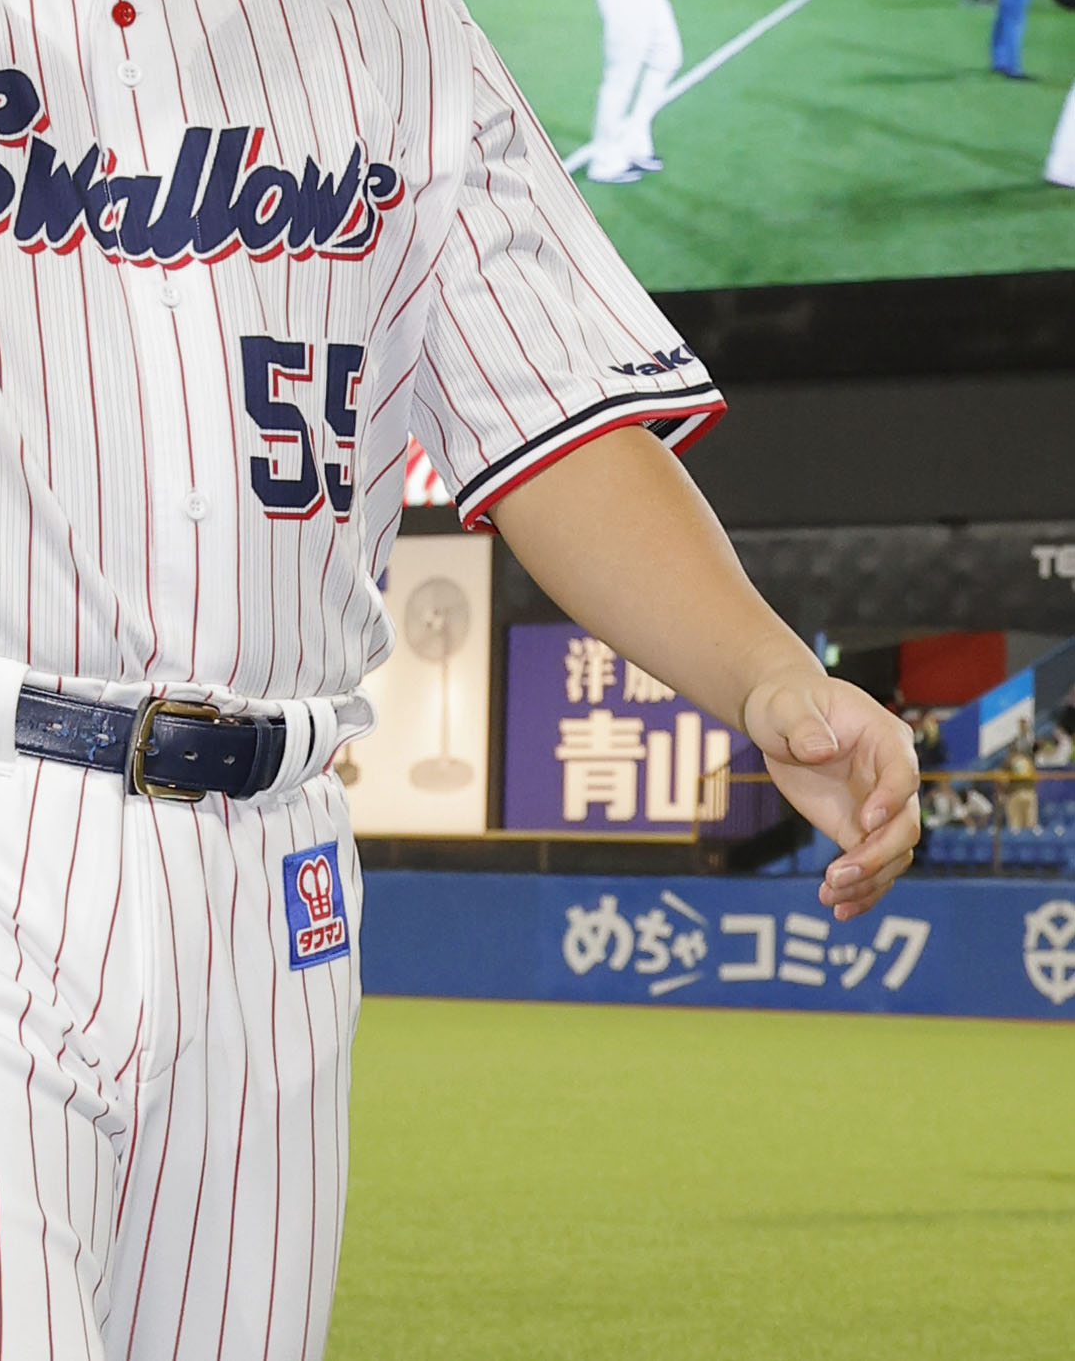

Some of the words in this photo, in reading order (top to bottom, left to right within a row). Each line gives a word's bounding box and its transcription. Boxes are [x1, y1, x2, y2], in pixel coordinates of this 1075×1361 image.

[608, 342, 696, 376] Yak
[239, 335, 366, 524] 55
[554, 709, 731, 822] 青山
[299, 921, 343, 953] タフマン
[562, 892, 931, 994] めちゃコミック
